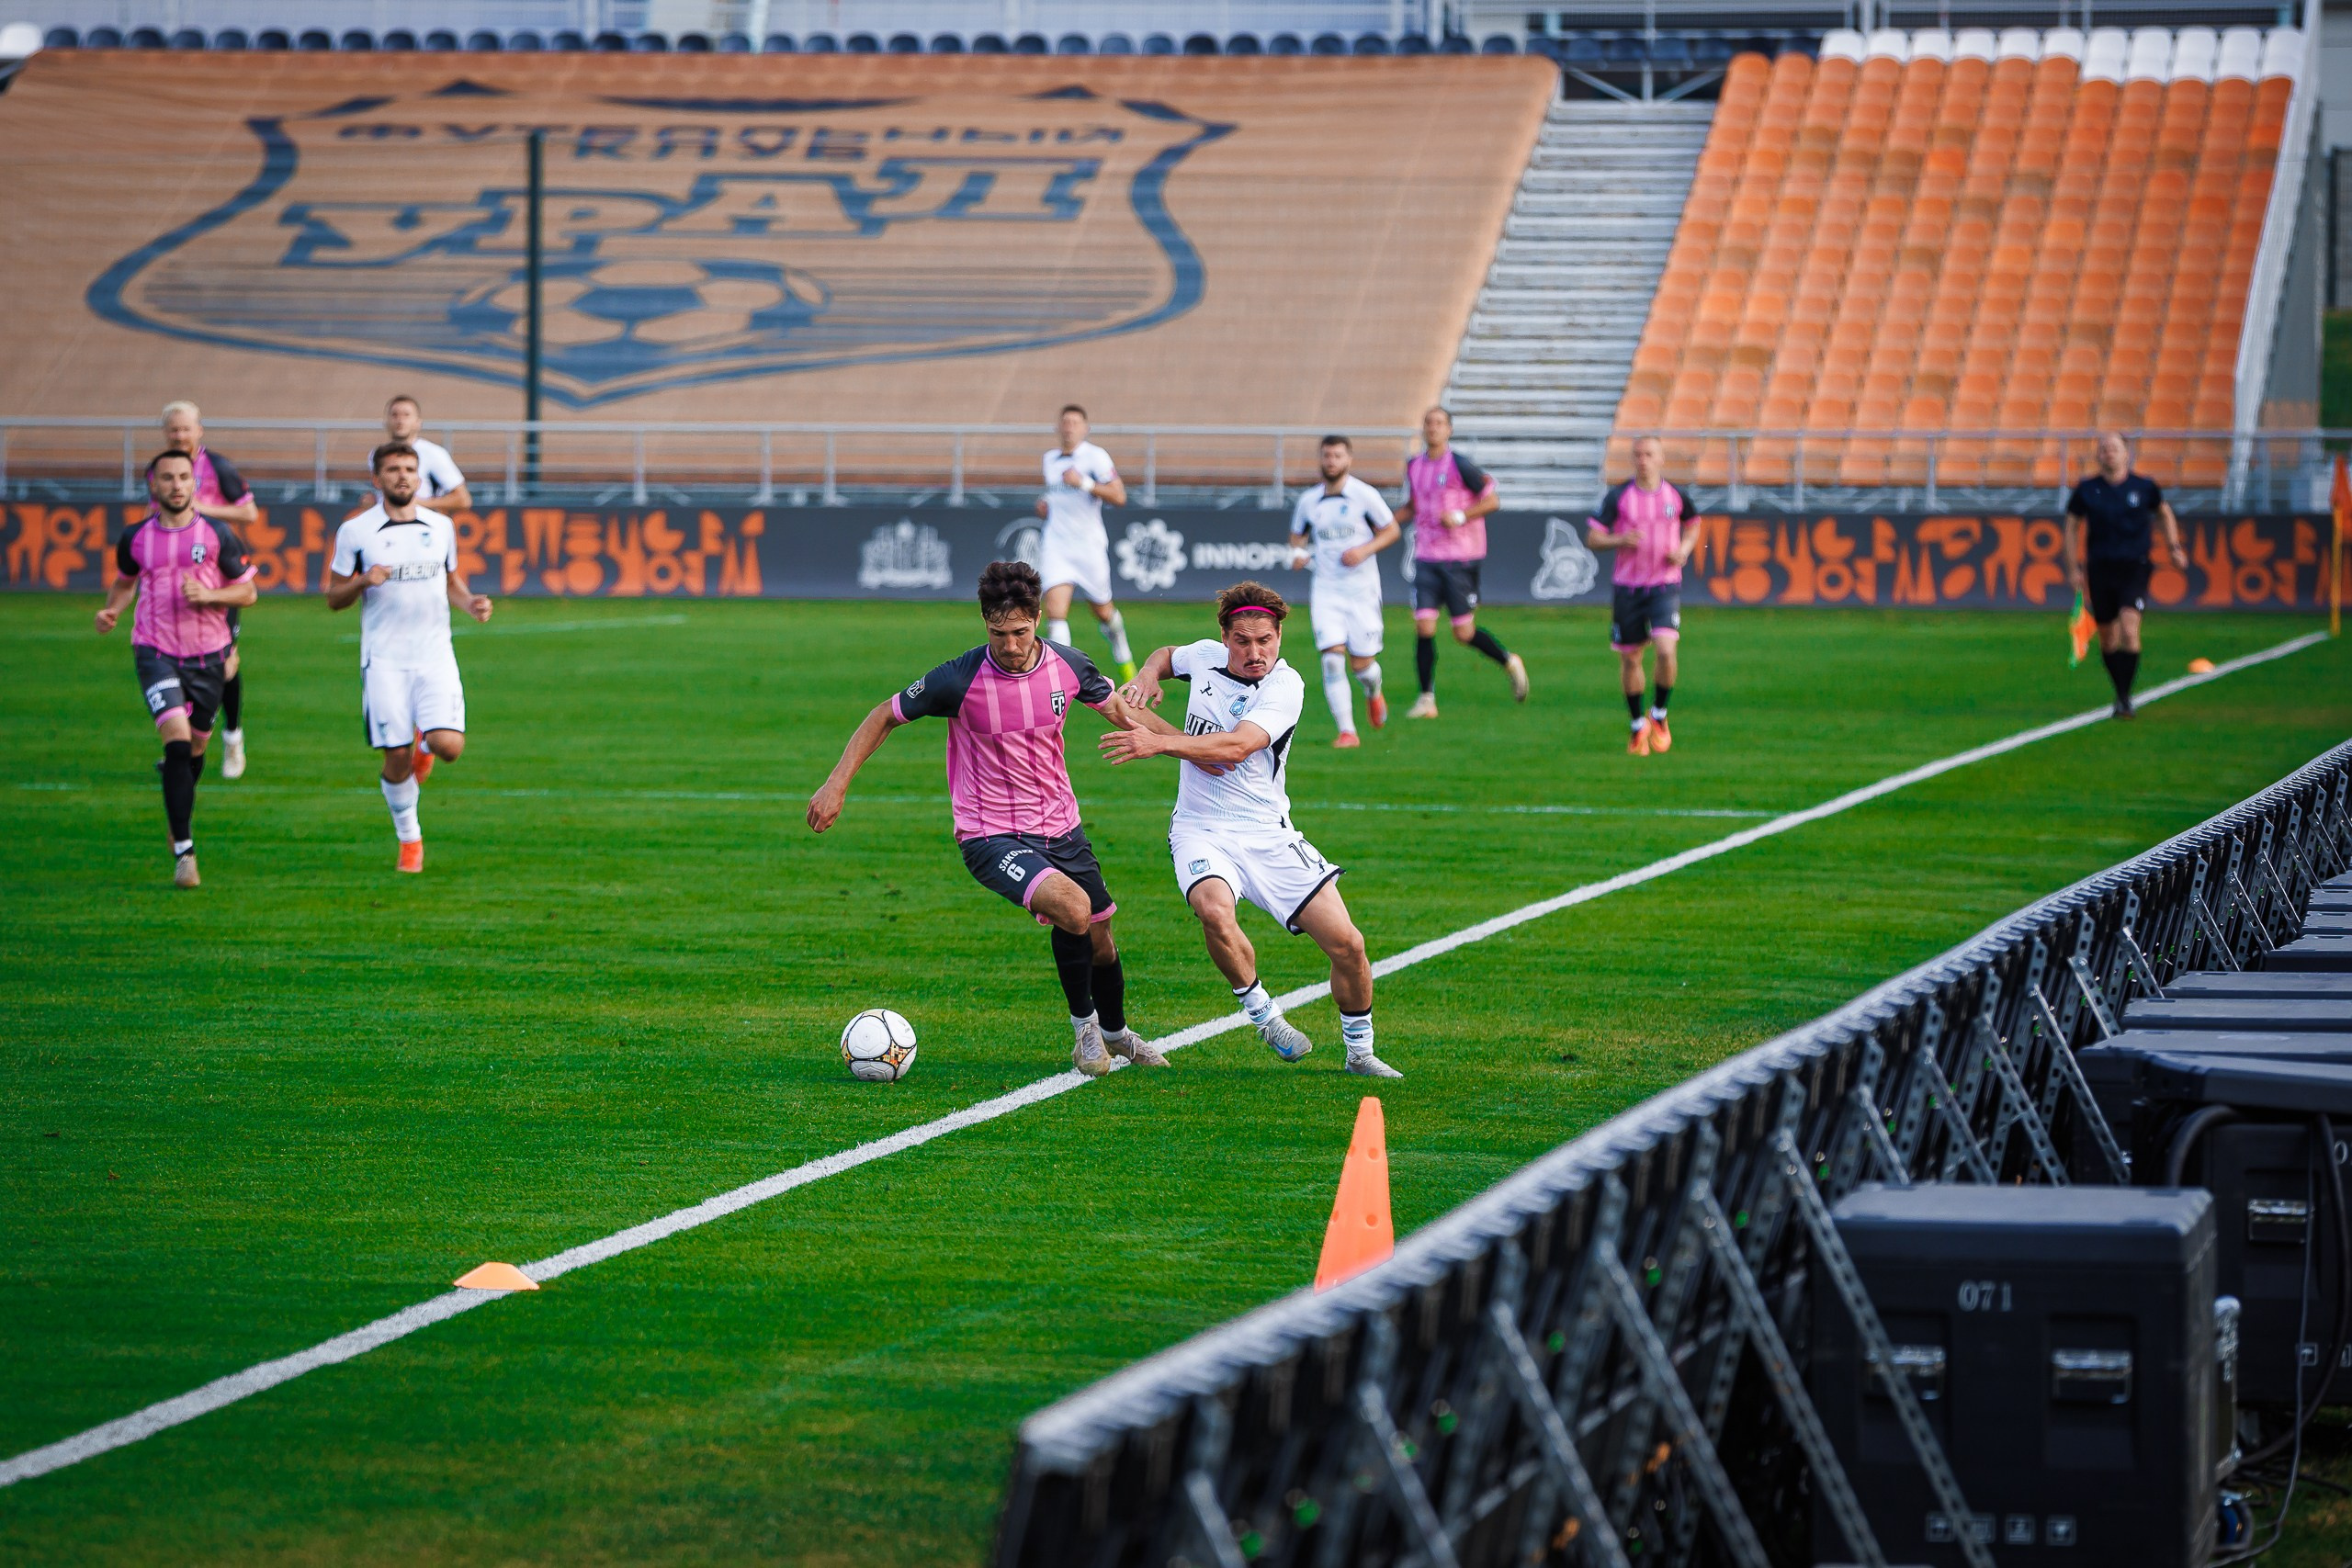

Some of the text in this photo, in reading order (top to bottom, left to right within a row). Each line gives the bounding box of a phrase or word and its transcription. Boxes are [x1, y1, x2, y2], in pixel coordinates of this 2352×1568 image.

[278, 157, 1103, 268] УРАЛ
[1051, 695, 1065, 716] FC
[1288, 840, 1323, 869] 10
[1006, 863, 1026, 882] 6
[1957, 1280, 2013, 1312] 071
